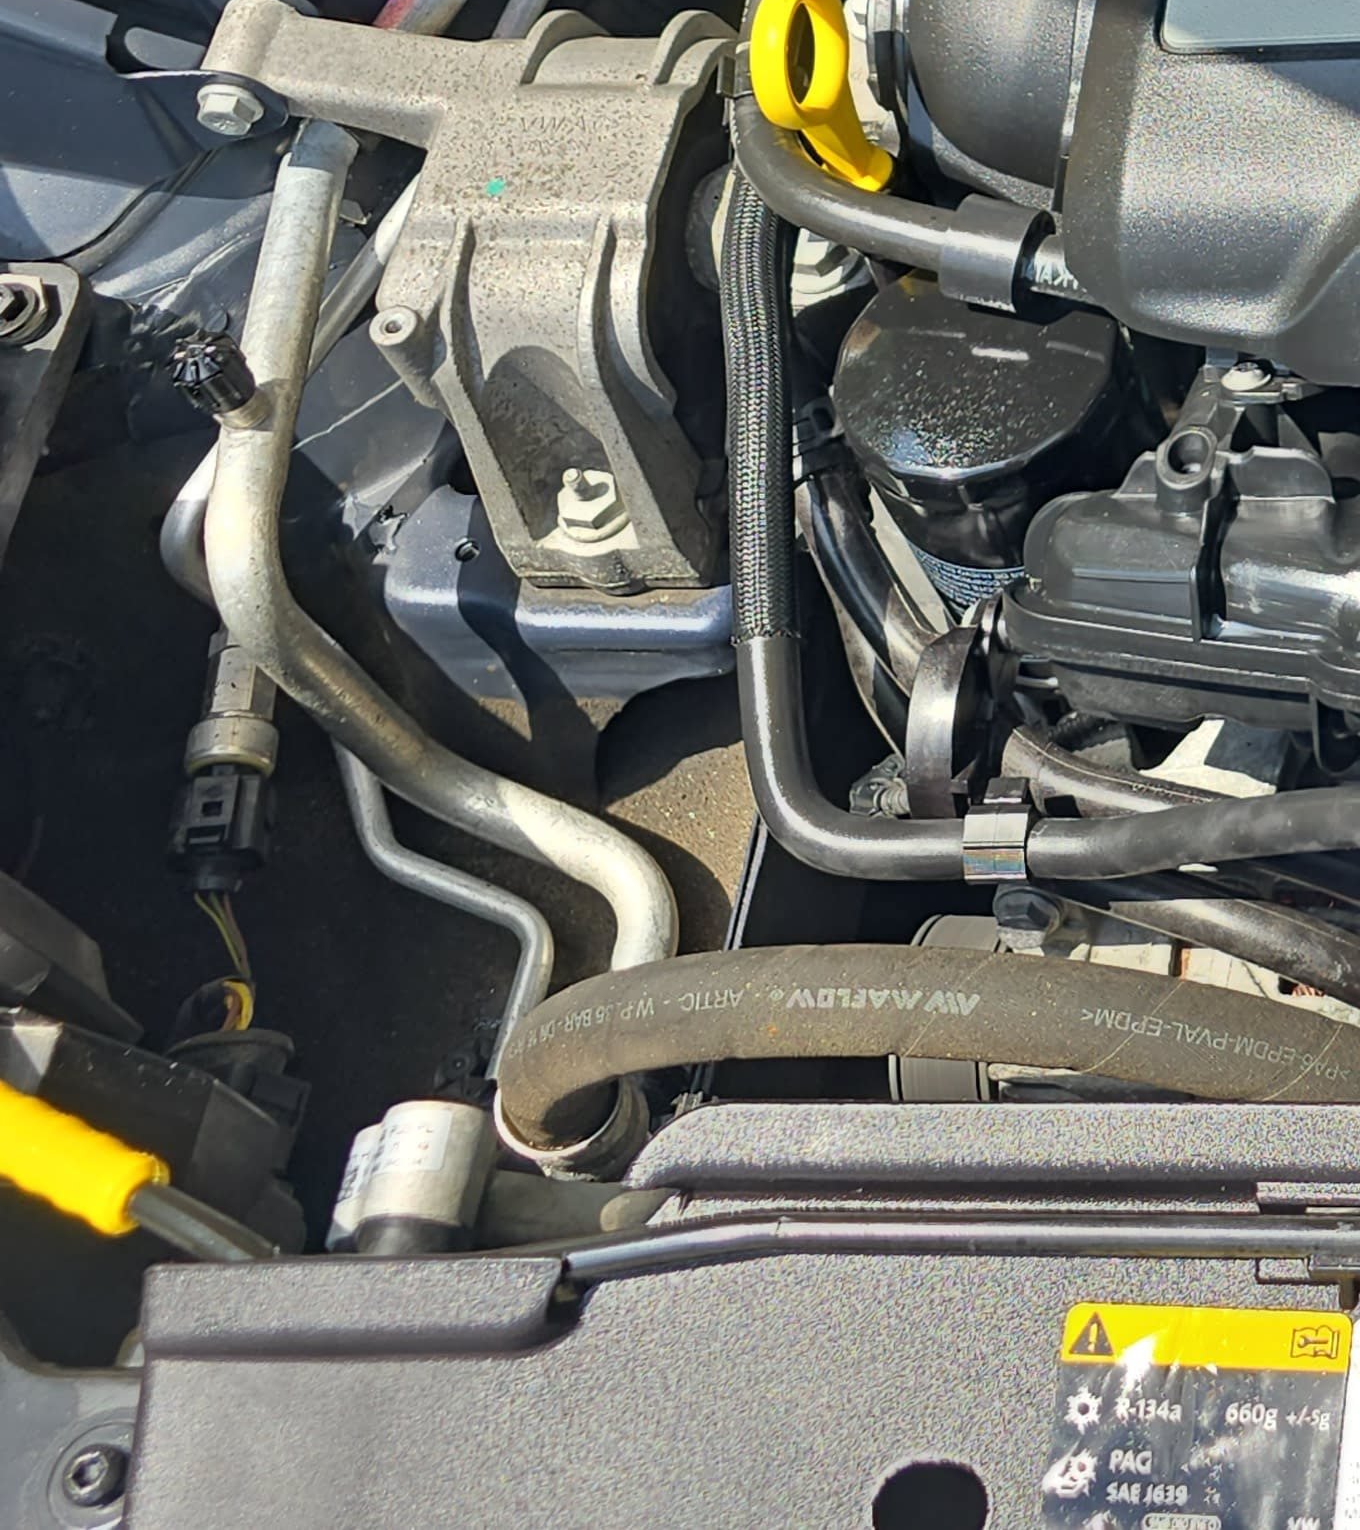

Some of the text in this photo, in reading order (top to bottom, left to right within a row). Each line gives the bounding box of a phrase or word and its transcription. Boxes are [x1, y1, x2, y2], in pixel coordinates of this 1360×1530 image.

[1114, 1398, 1183, 1423] R-134a
[1224, 1403, 1279, 1432] 660g
[1109, 1449, 1153, 1475] PAG
[1106, 1482, 1142, 1506] SAE
